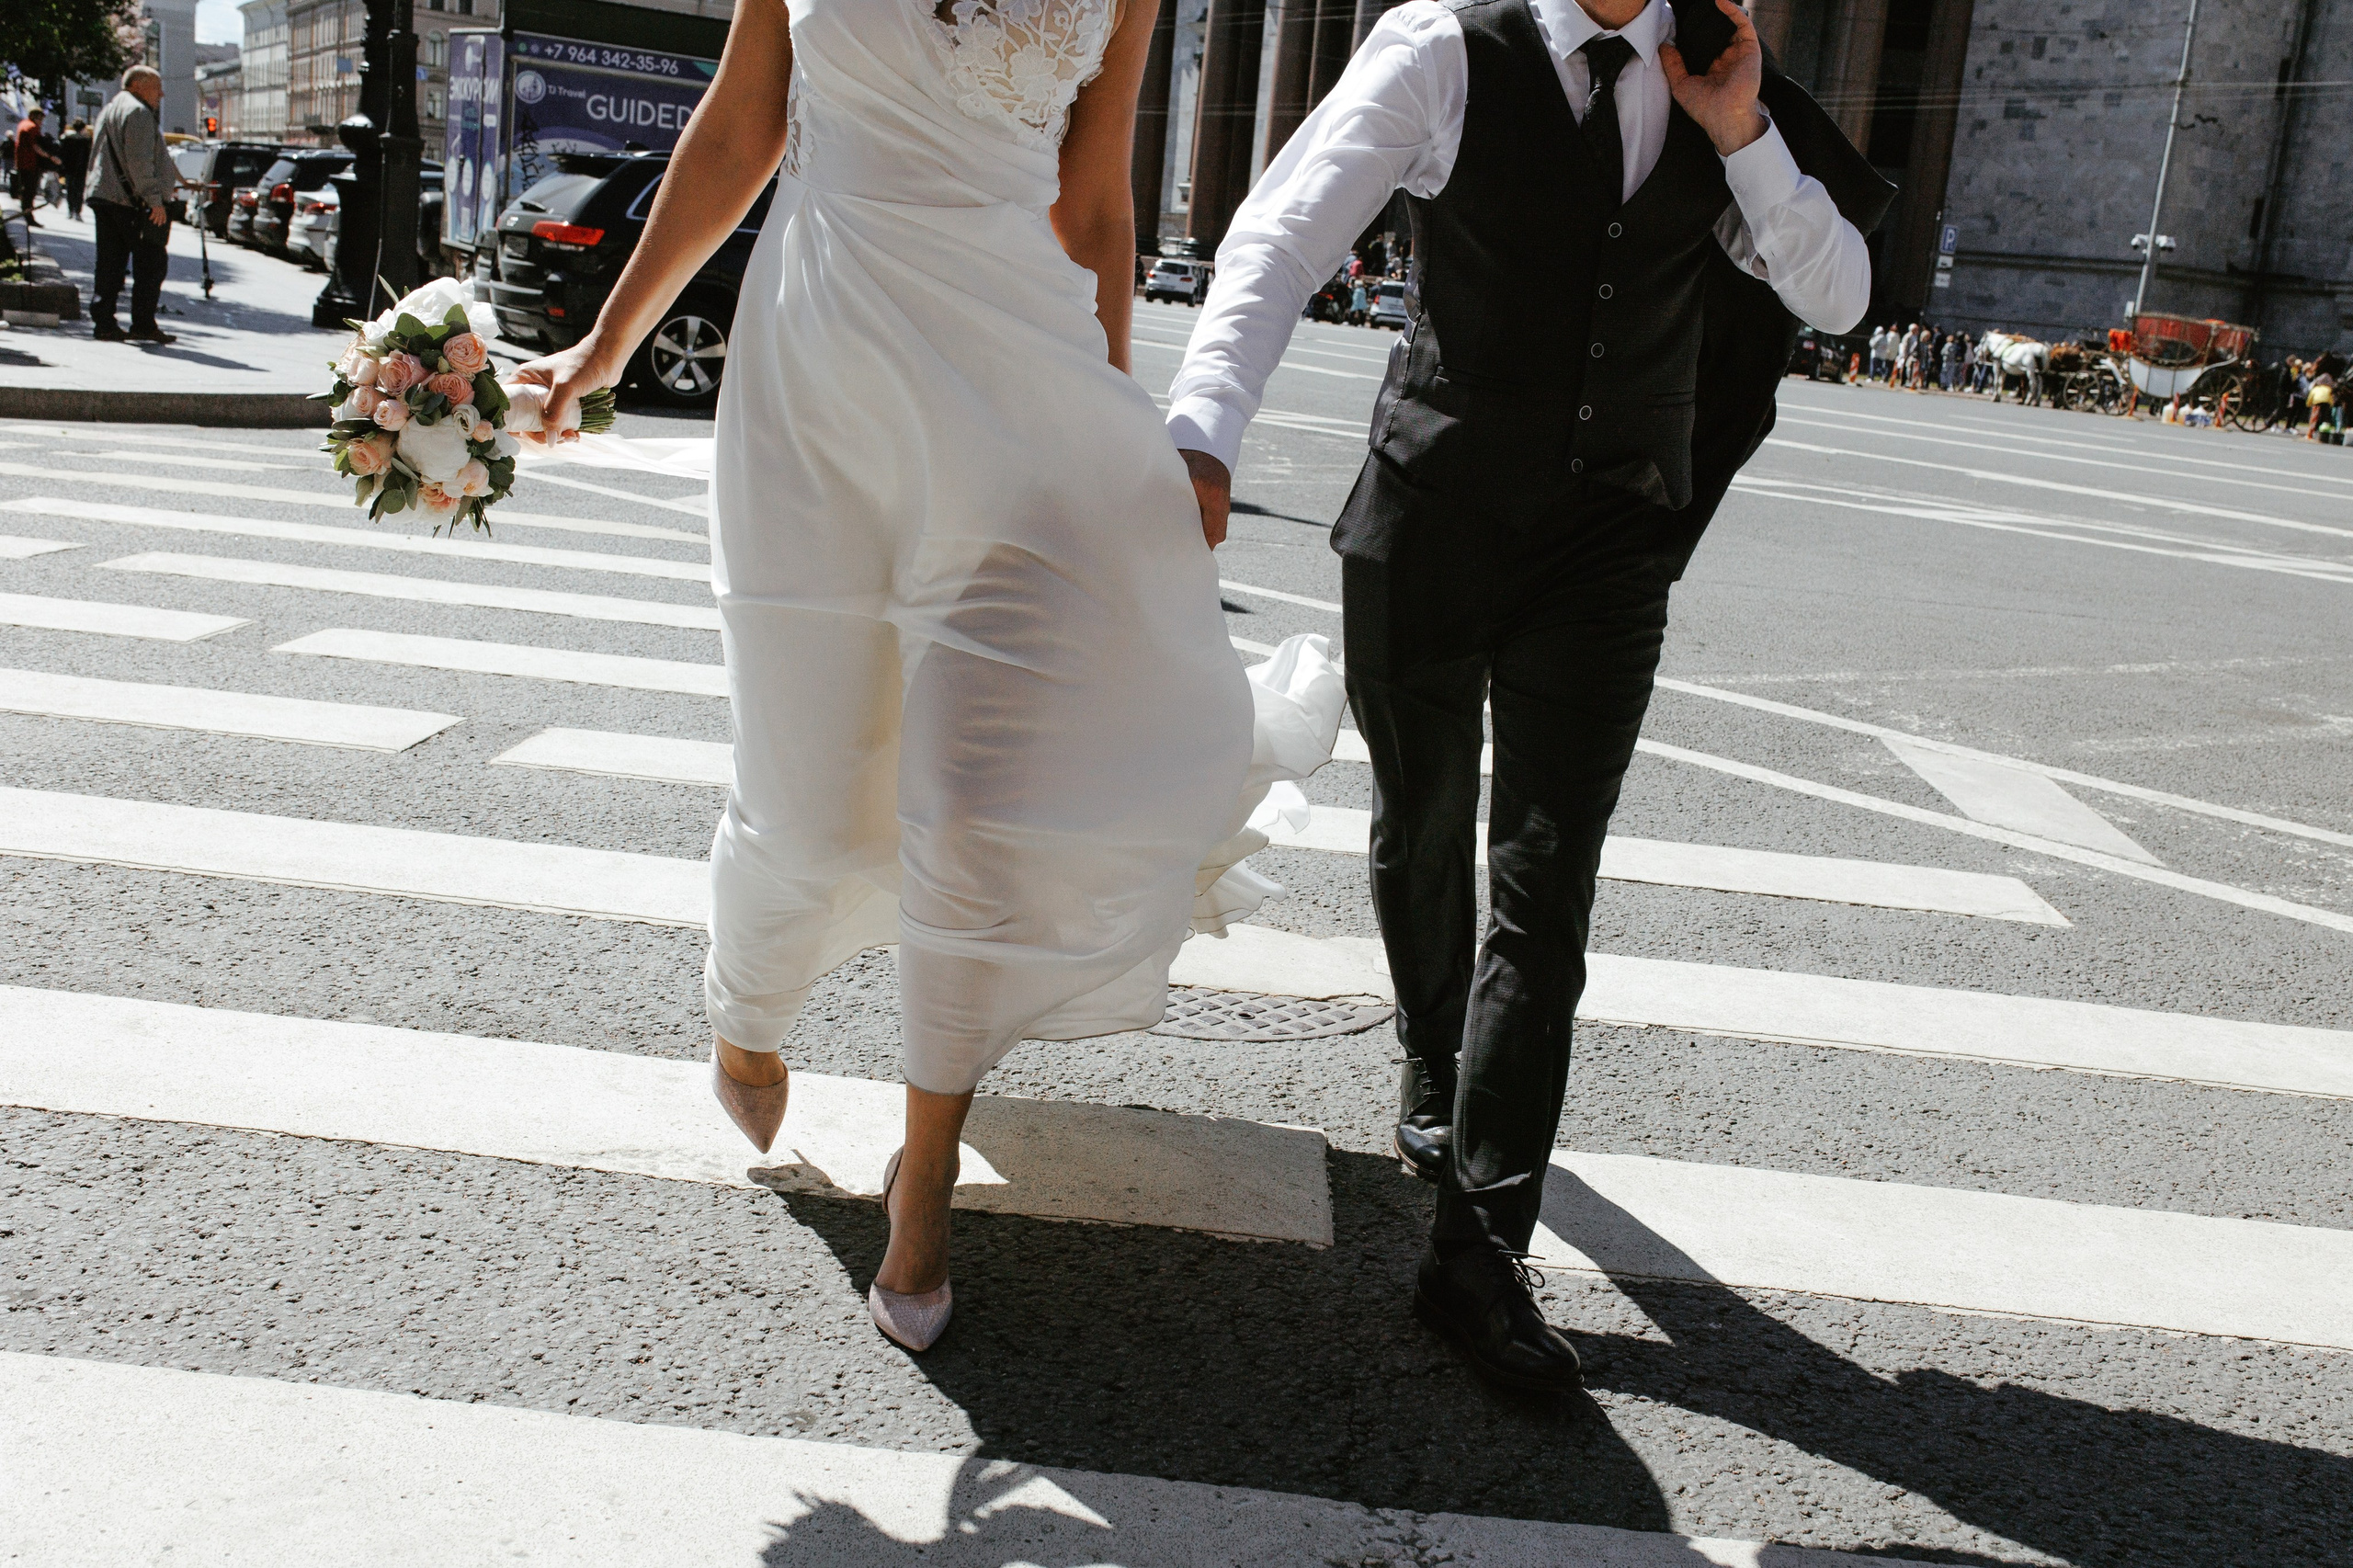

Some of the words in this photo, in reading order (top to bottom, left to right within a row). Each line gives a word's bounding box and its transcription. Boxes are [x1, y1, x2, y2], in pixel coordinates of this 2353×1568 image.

[544, 44, 563, 60] +7
[567, 46, 597, 63] 964
[601, 50, 679, 75] 342-35-96
[558, 85, 586, 99] Travel
[586, 95, 694, 131] GUIDED
